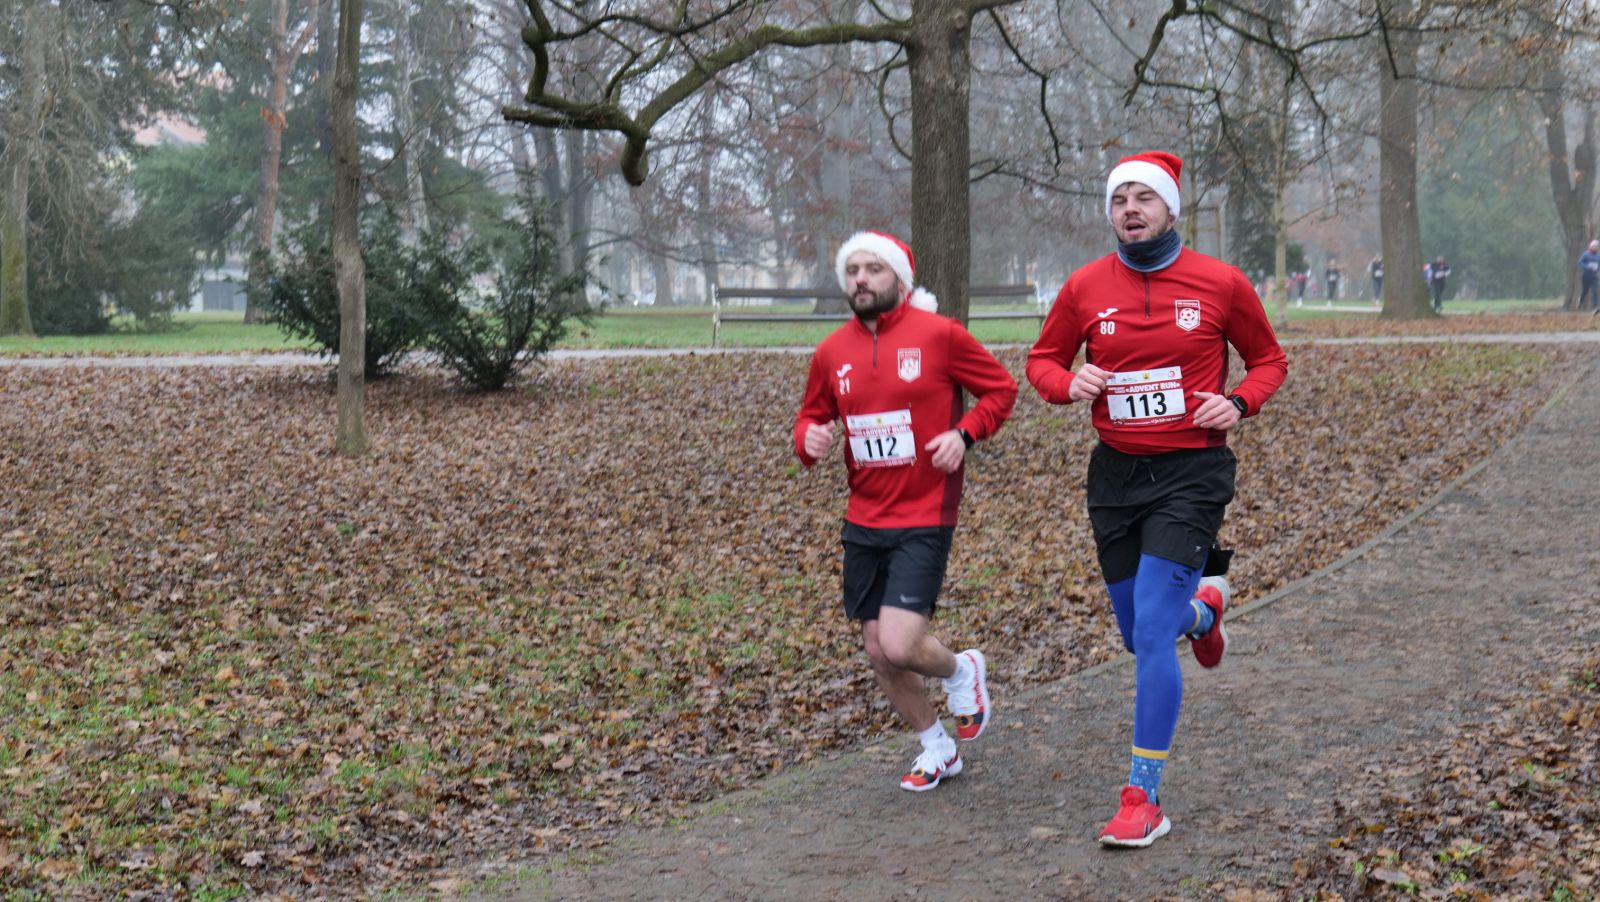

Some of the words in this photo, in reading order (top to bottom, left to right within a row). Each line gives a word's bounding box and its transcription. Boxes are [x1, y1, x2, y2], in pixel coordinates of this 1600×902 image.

[1100, 321, 1115, 335] 80
[1126, 392, 1167, 417] 113
[864, 437, 899, 458] 112
